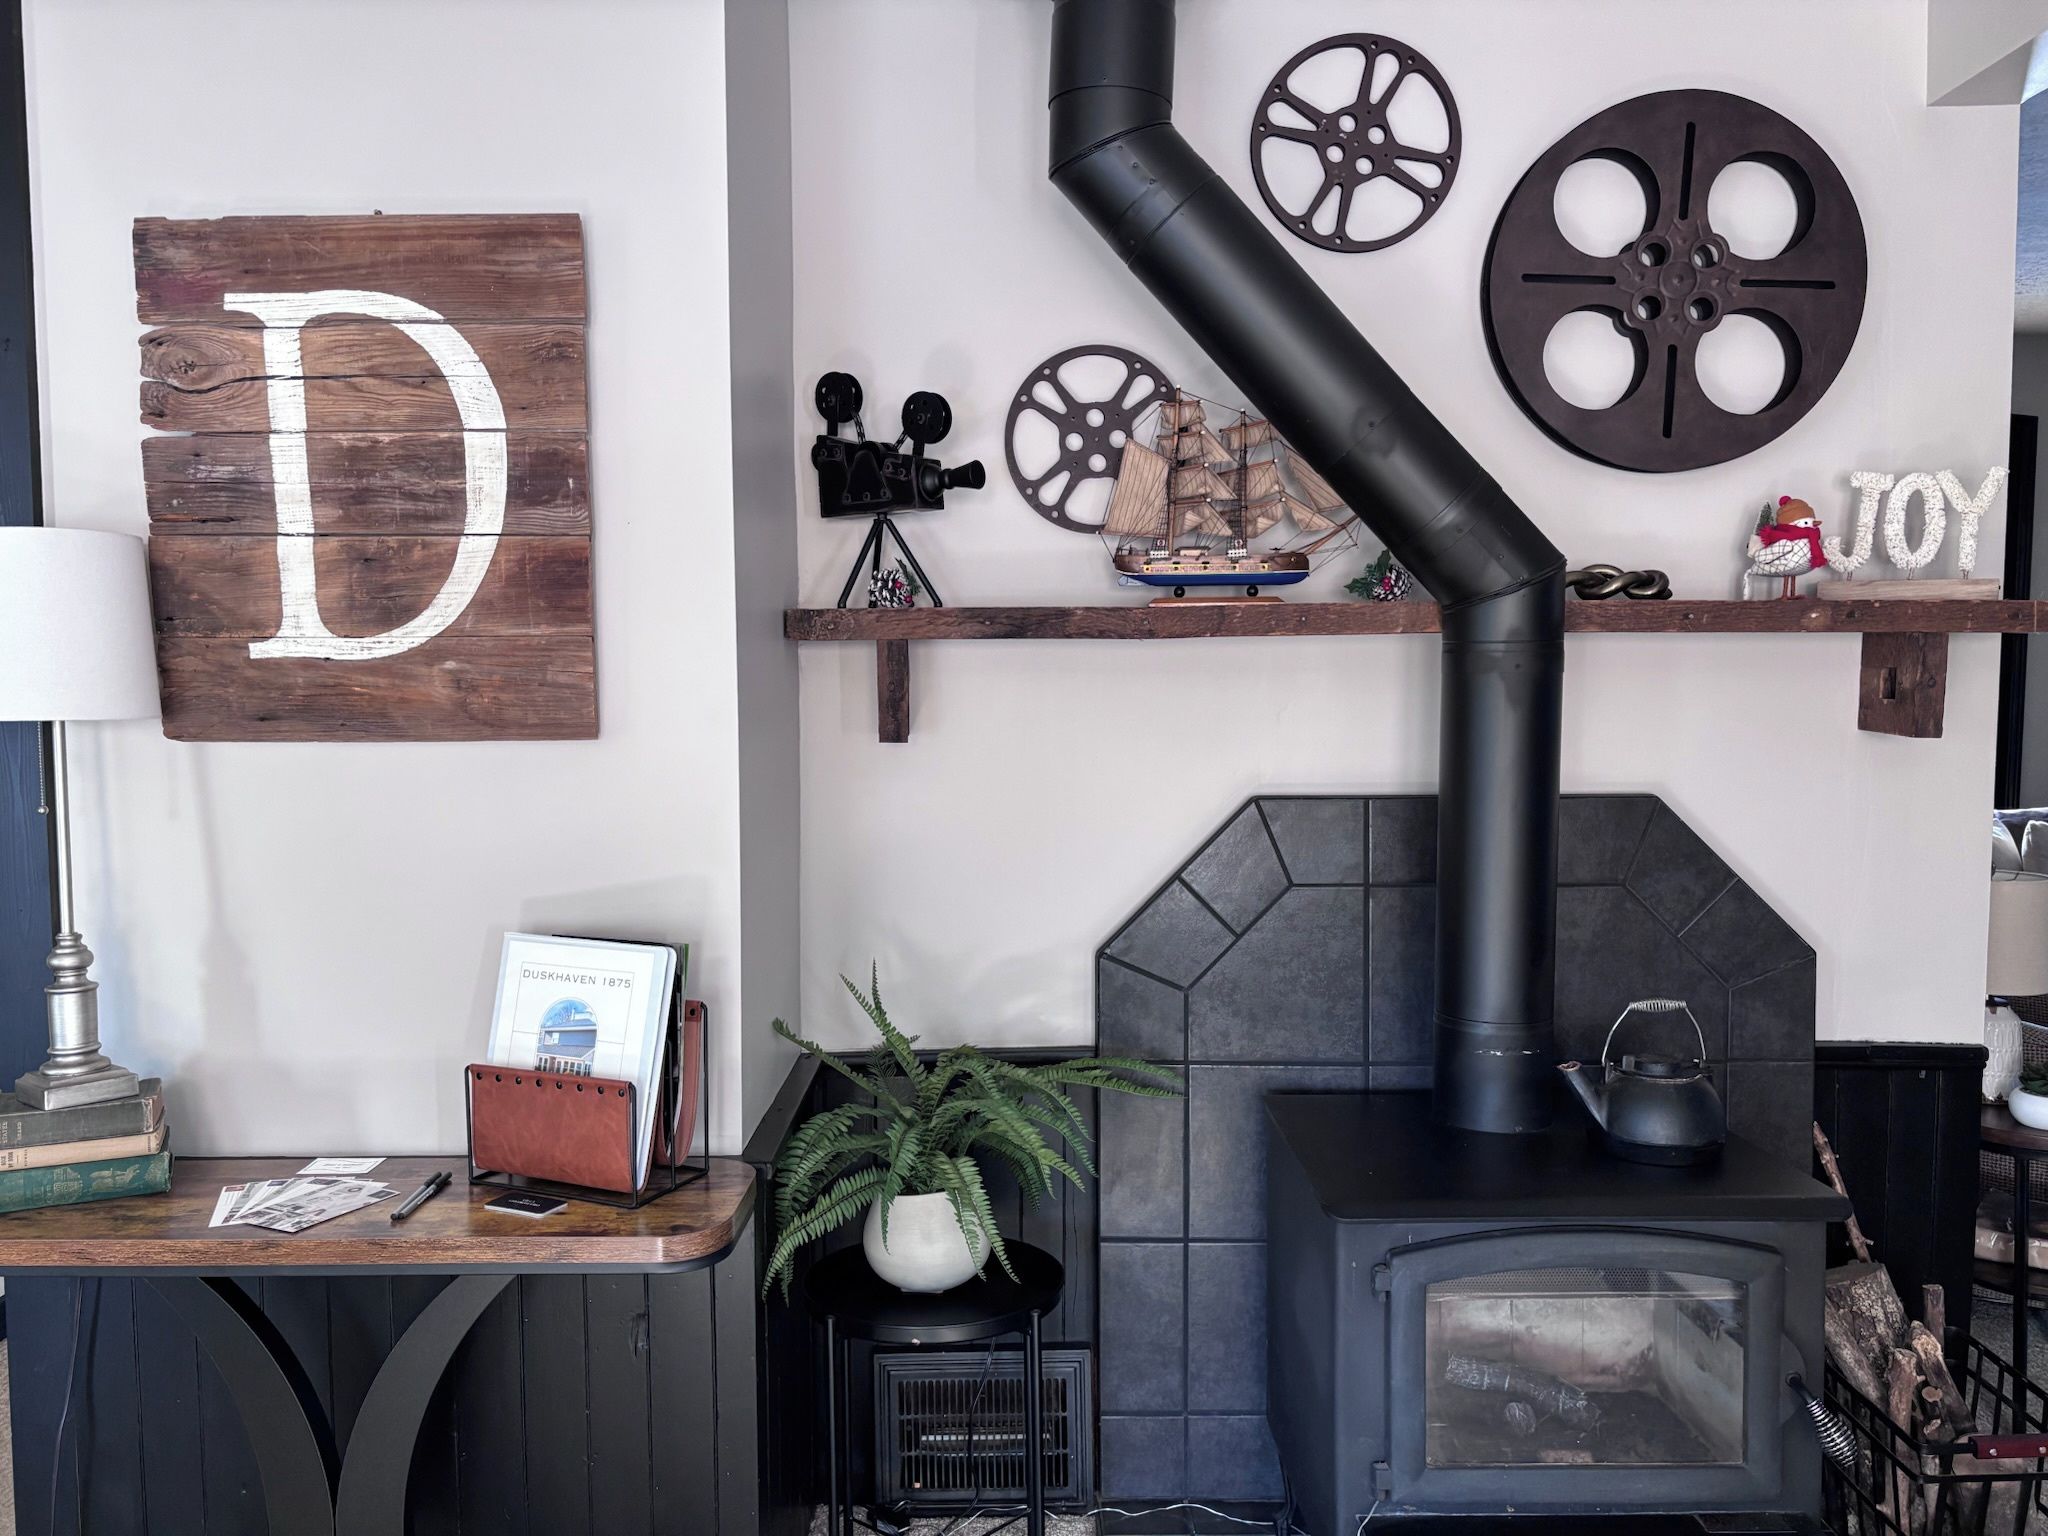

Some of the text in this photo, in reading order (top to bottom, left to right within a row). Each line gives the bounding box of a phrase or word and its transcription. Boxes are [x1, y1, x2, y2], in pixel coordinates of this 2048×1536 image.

[223, 289, 508, 660] D
[1823, 465, 2010, 573] JOY
[522, 968, 632, 989] DUSKHAVEN 1875
